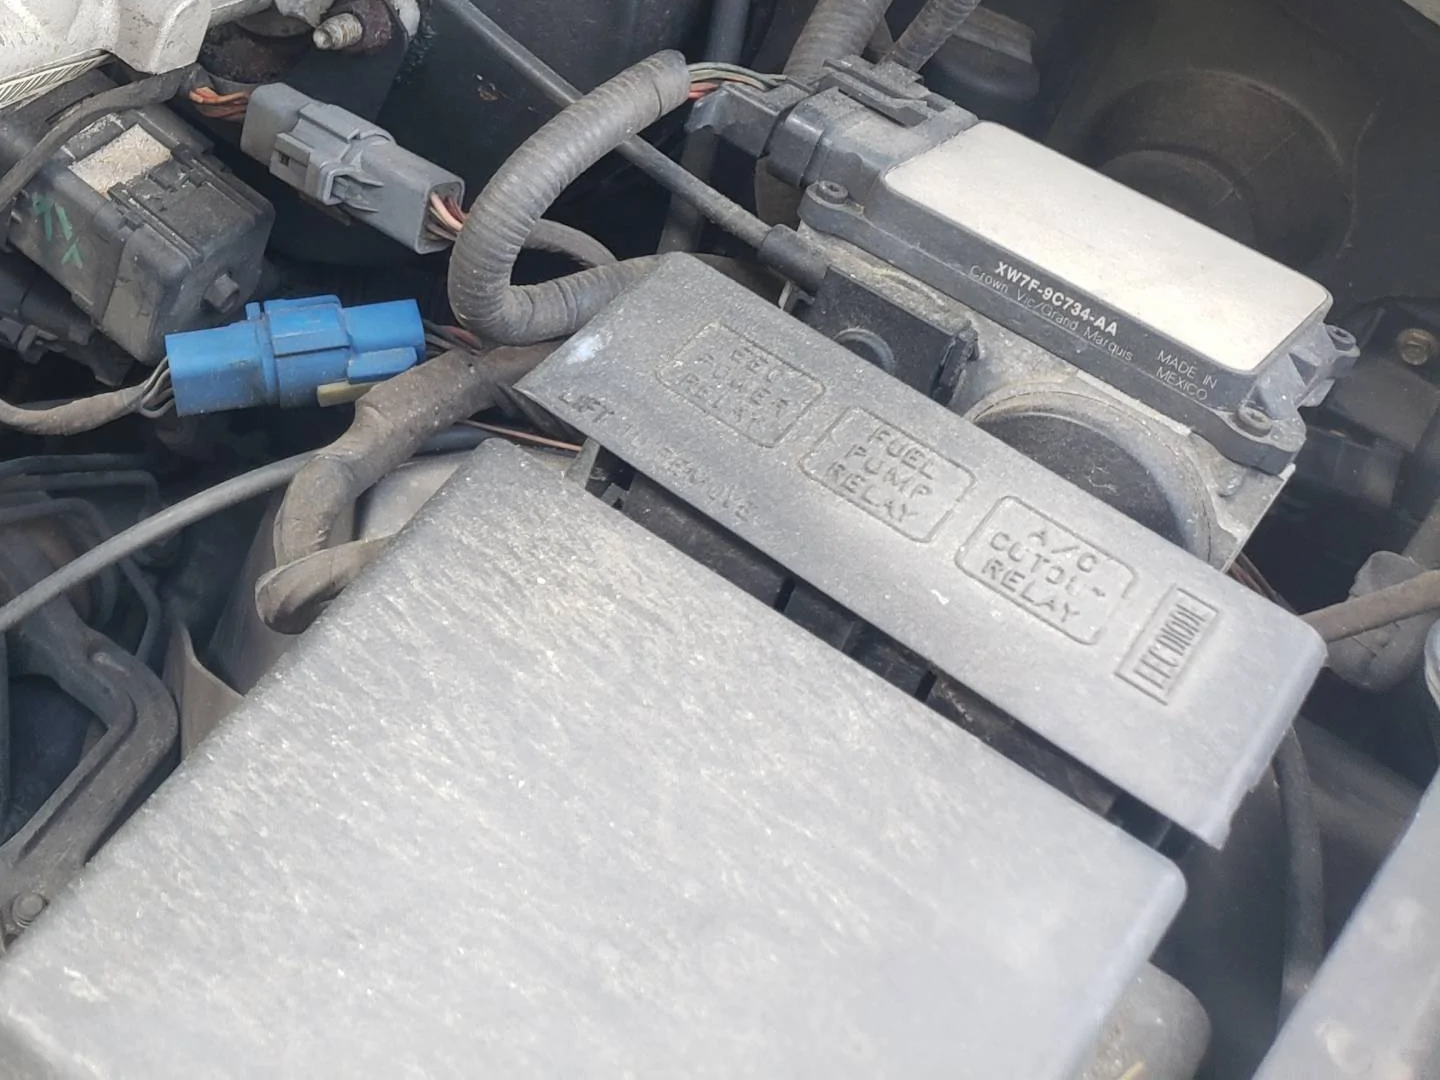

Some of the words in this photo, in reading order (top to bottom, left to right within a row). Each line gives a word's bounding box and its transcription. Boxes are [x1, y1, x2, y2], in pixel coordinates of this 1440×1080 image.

[967, 263, 1011, 295] Crown
[1013, 288, 1080, 332] Vic/Grand
[1081, 325, 1135, 364] Marquis
[993, 260, 1118, 337] XW7F-9C734-AA
[1154, 364, 1210, 402] MEXICO
[1155, 348, 1198, 380] MADE
[1201, 373, 1218, 391] IN
[843, 441, 935, 498] PUMP
[865, 424, 936, 480] FUEL
[823, 459, 919, 523] RELAY
[988, 528, 1107, 599] CUTO
[1026, 526, 1100, 575] A/C
[980, 555, 1082, 623] RELAY
